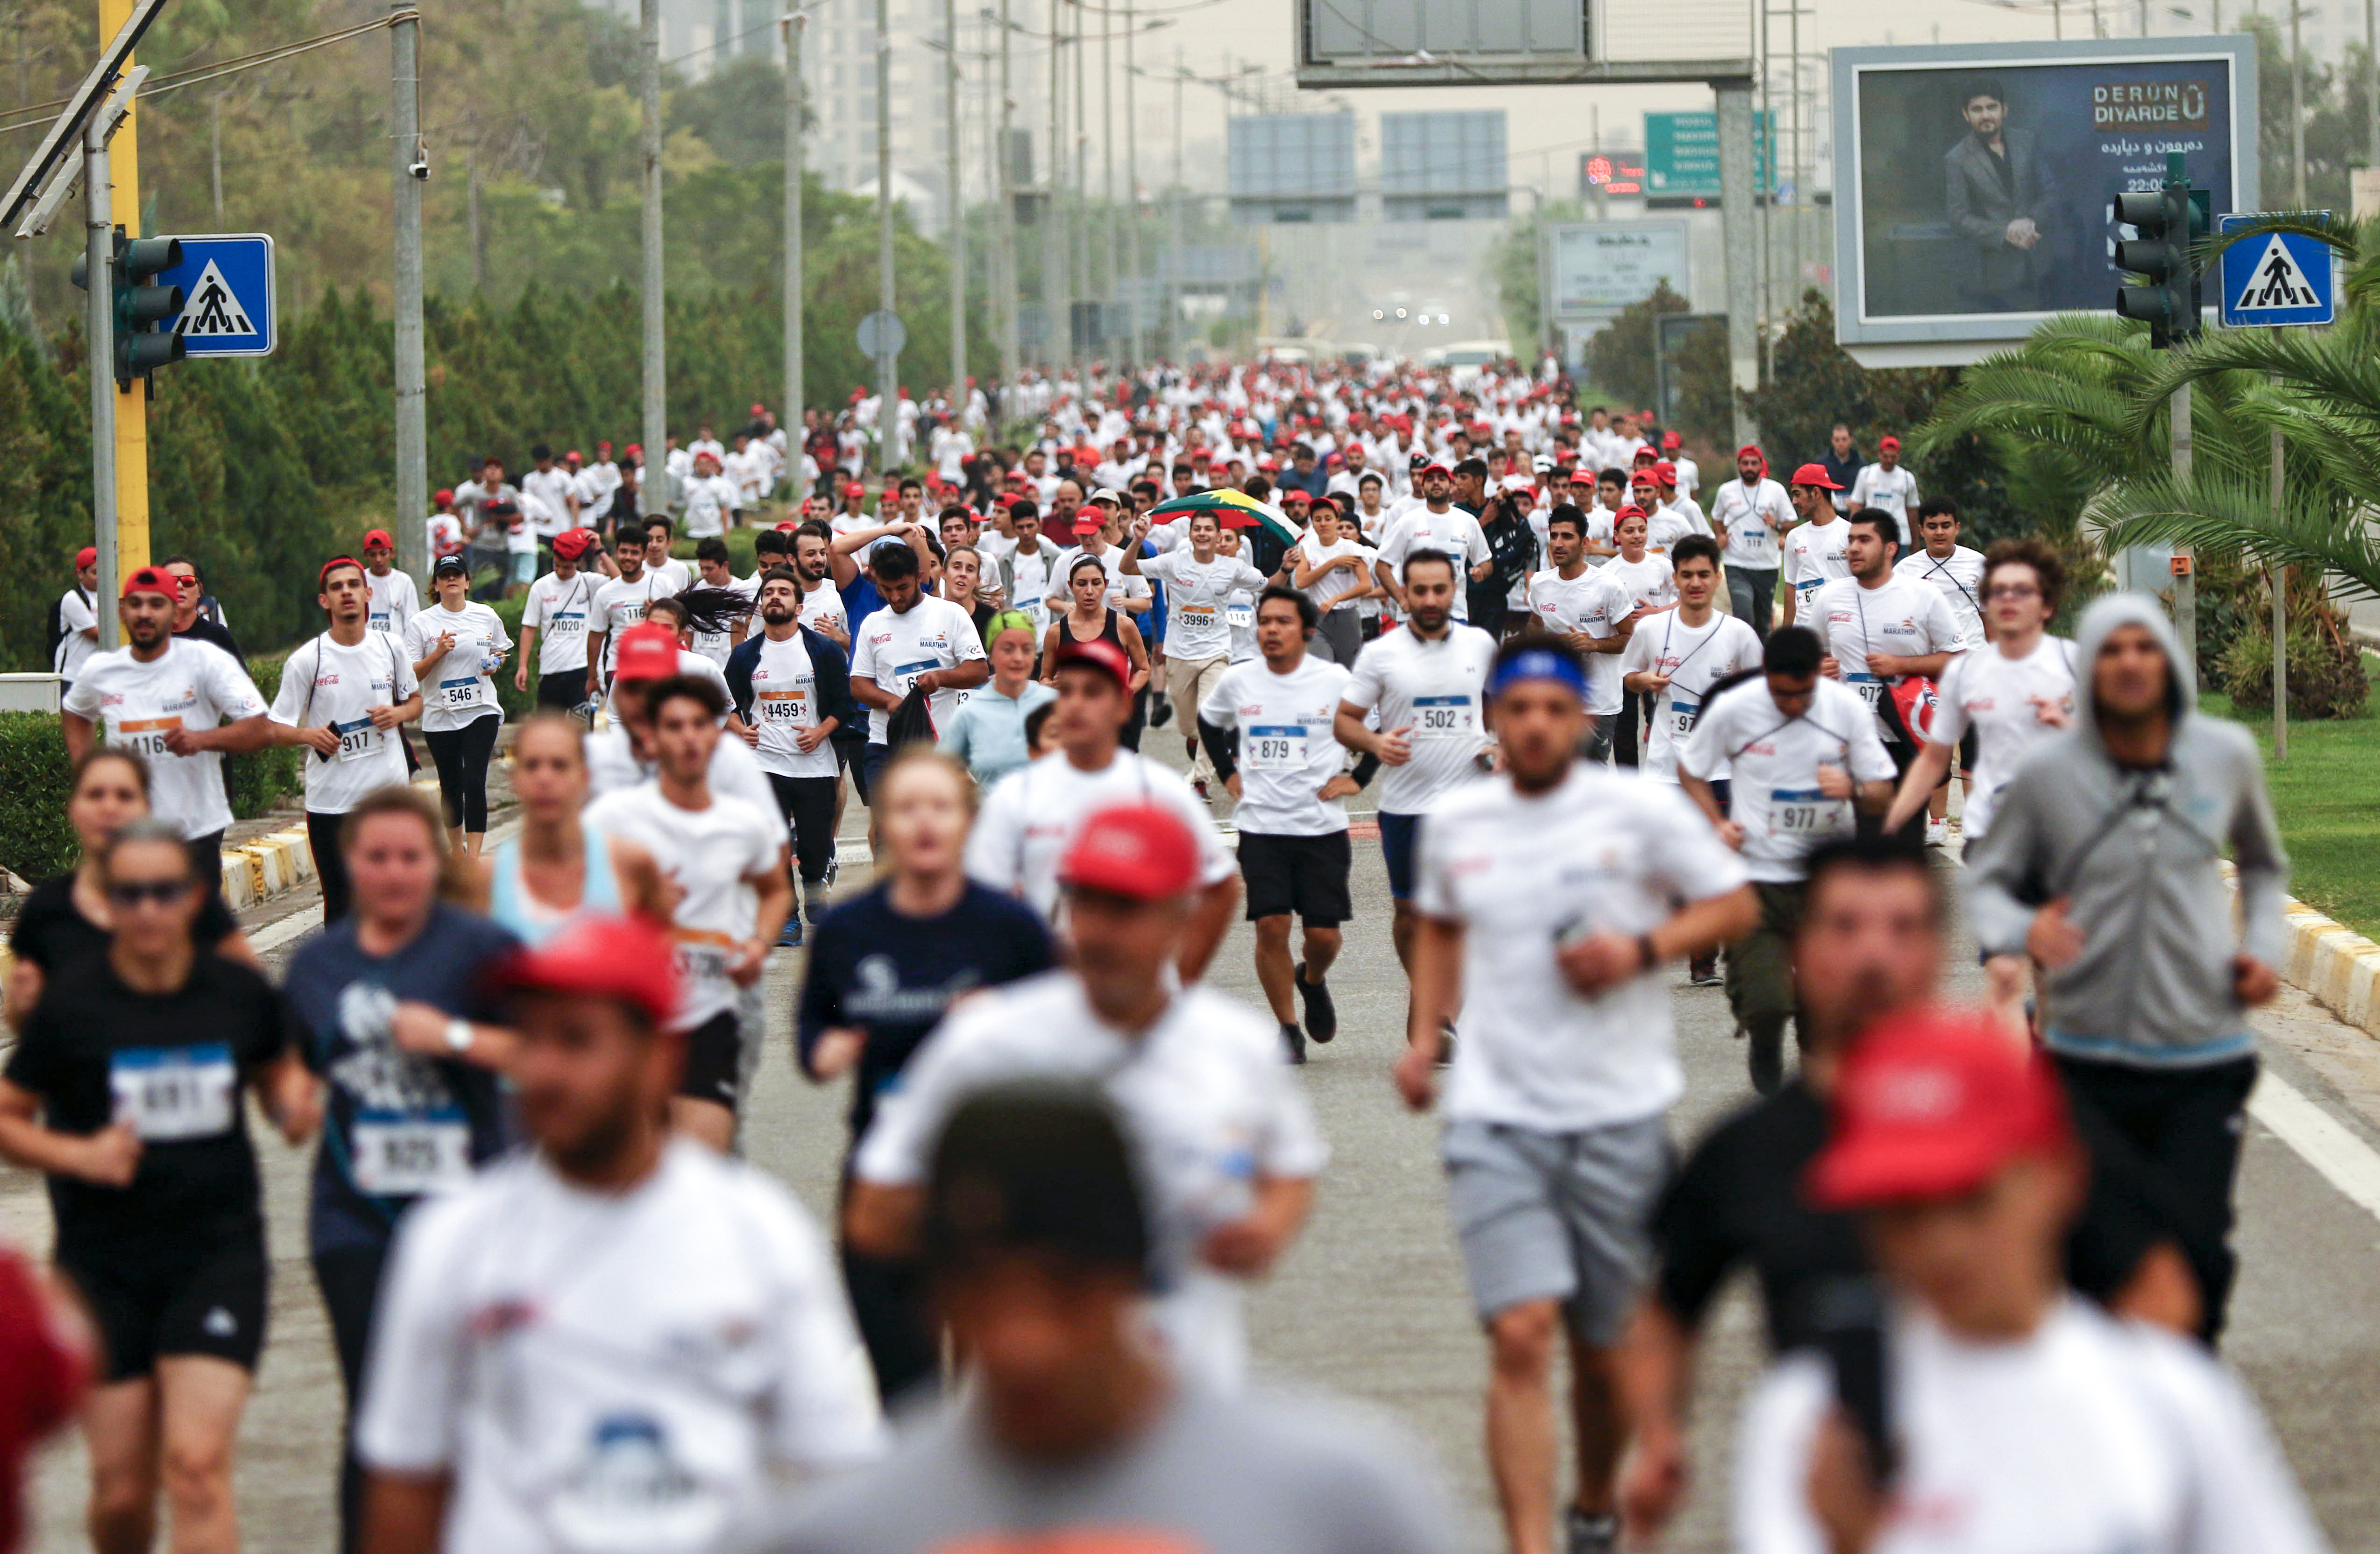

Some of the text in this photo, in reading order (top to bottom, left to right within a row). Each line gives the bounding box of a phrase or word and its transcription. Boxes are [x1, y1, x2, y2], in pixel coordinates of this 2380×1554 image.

[2095, 105, 2179, 122] DIYARDE
[2128, 178, 2164, 192] 22:0
[1184, 614, 1209, 626] 3996
[1229, 613, 1246, 622] 114
[1828, 612, 1853, 622] Coca-Cola
[557, 621, 579, 631] 1020
[870, 633, 892, 644] Coca-Cola
[450, 688, 471, 702] 546
[768, 703, 799, 717] 4459
[1425, 710, 1456, 728] 502
[1679, 715, 1697, 733] 97
[132, 735, 174, 755] 416
[342, 731, 368, 752] 917
[1262, 741, 1289, 758] 879
[1784, 807, 1816, 828] 977
